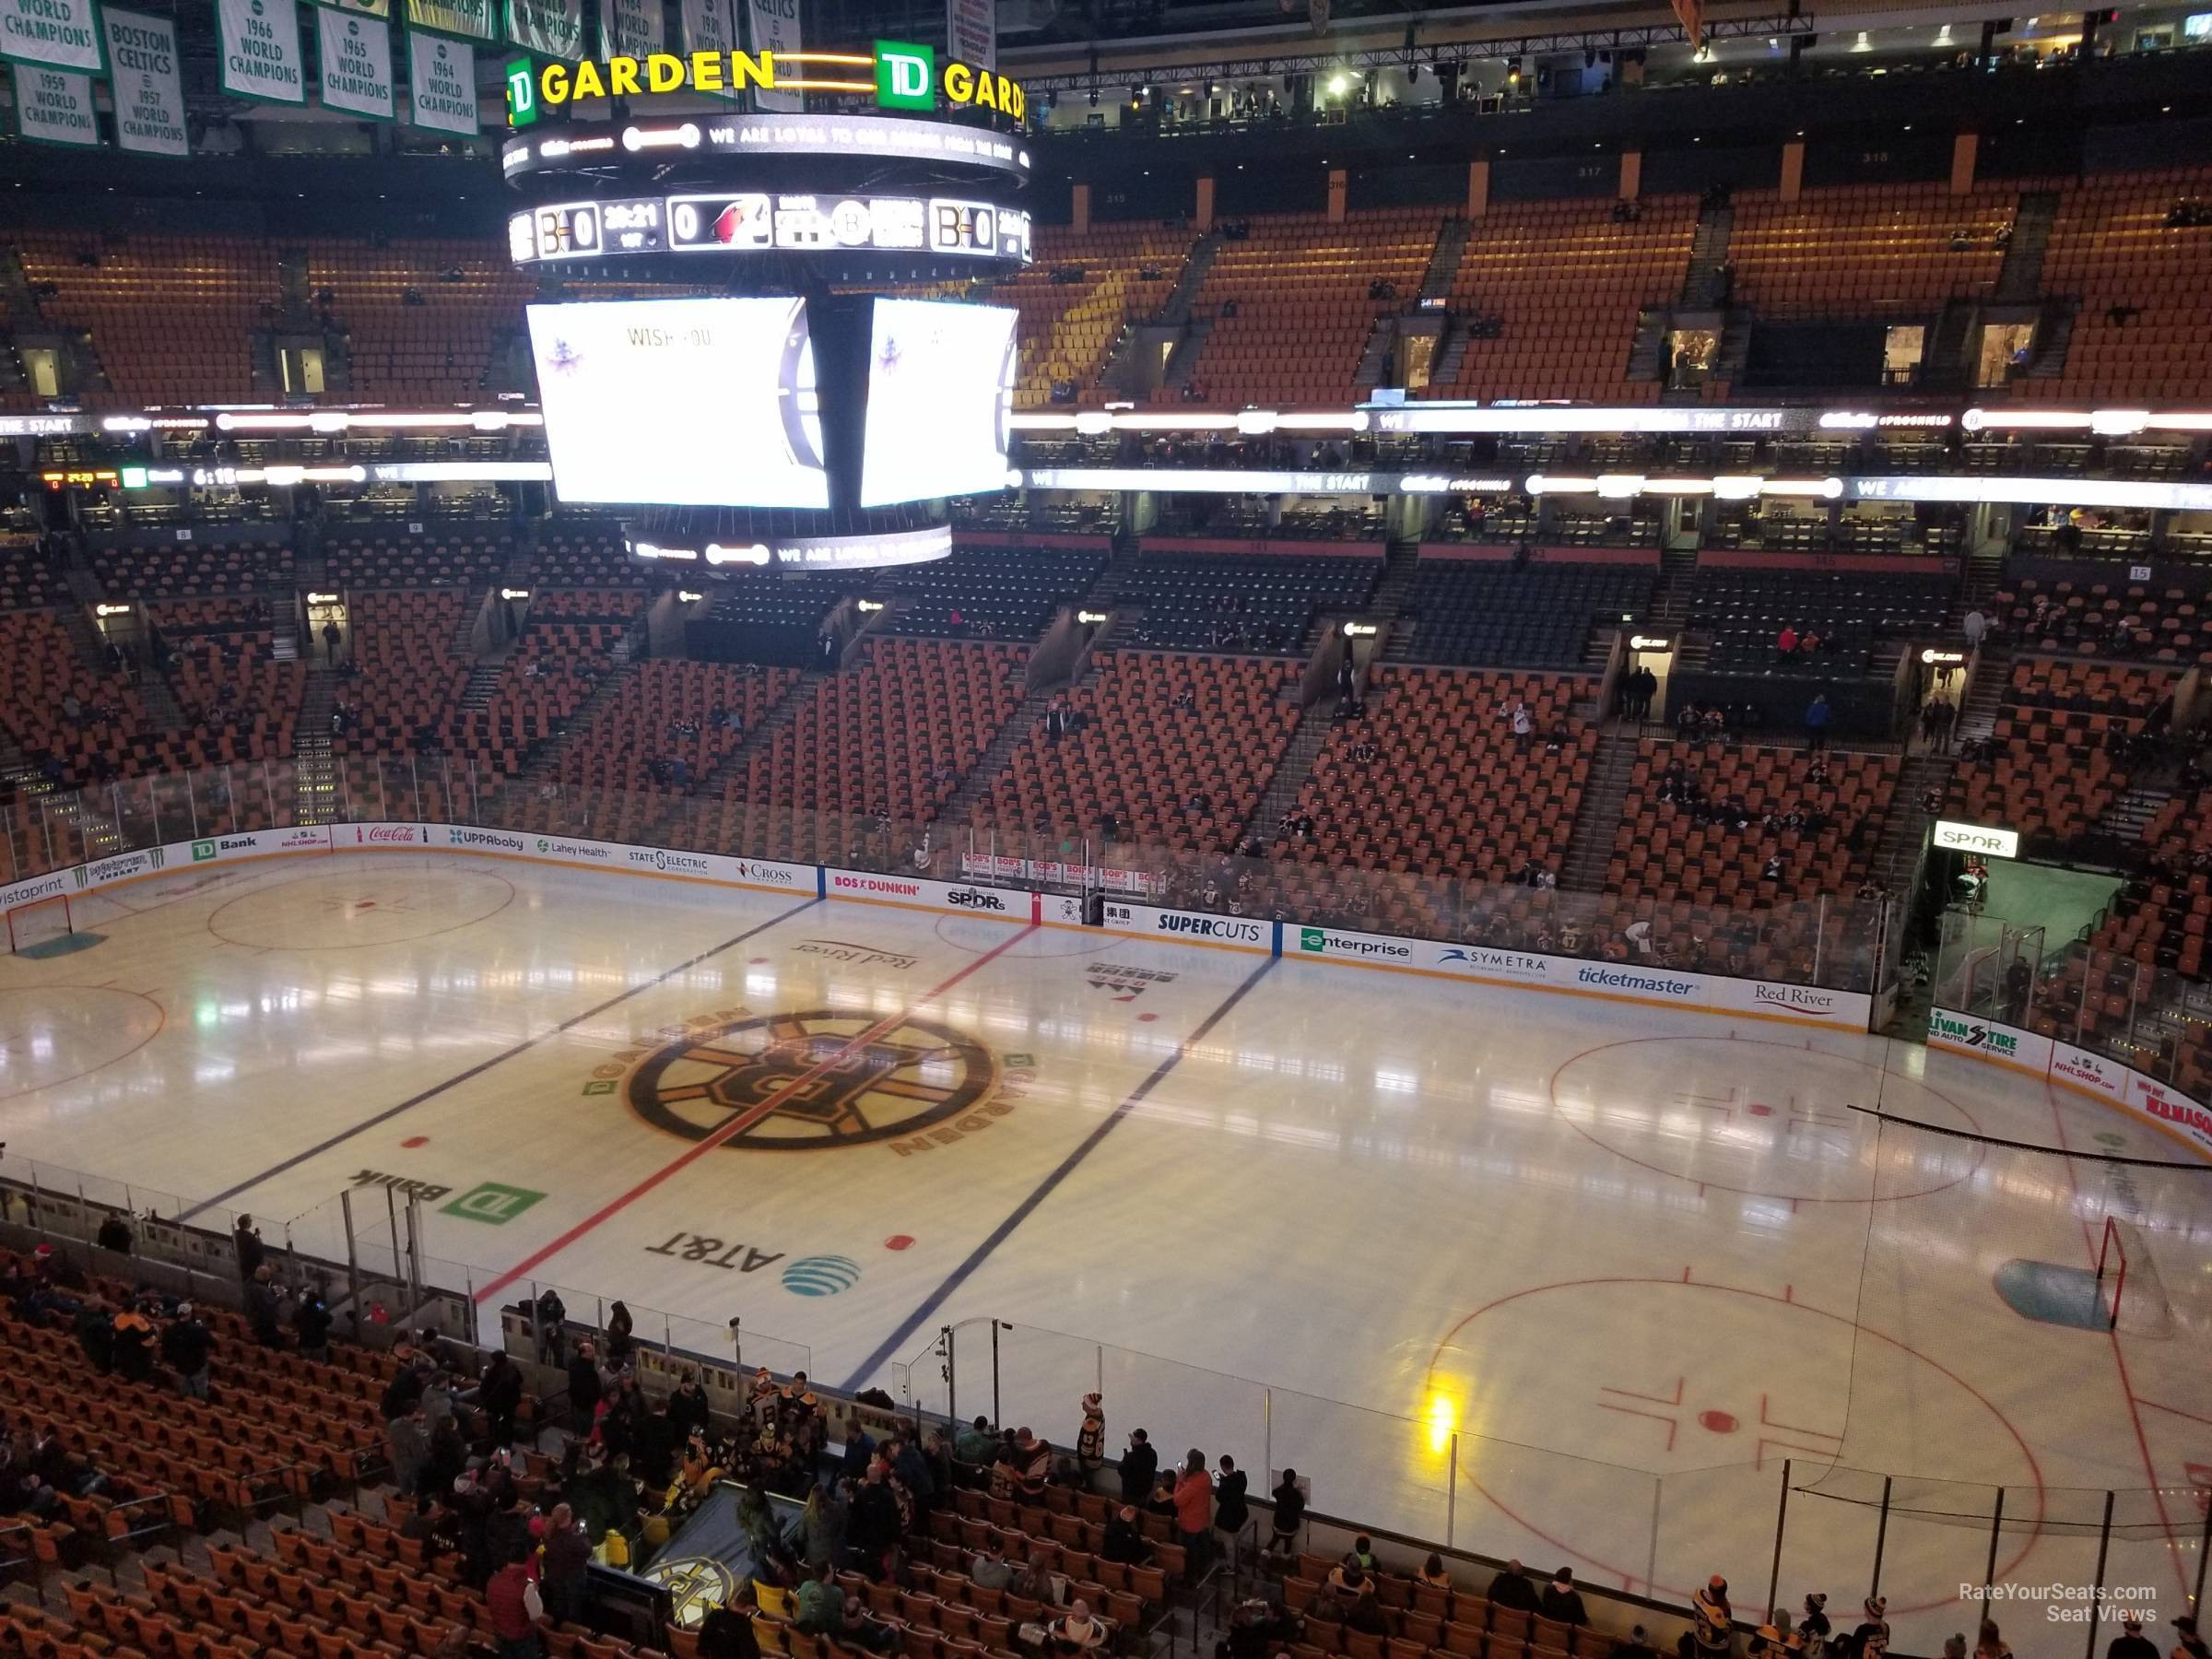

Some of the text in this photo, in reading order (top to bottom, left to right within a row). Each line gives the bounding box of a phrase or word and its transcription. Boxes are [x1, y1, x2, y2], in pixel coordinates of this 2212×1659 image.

[18, 0, 71, 21] WORLD
[6, 15, 91, 48] CHAMPIONS
[111, 23, 171, 53] BOSTON
[245, 18, 272, 39] 1966
[241, 38, 283, 61] WORLD
[343, 39, 366, 57] 1965
[117, 48, 171, 75] CELTICS
[229, 55, 298, 85] CHAMPIONS
[337, 57, 374, 78] WORLD
[433, 61, 454, 77] 1964
[41, 74, 65, 89] 1959
[541, 50, 774, 105] GARDEN
[881, 53, 929, 97] TD
[140, 89, 160, 105] 1957
[327, 73, 388, 100] CHAMPIONS
[429, 77, 462, 98] WORLD
[36, 90, 76, 111] WORLD
[418, 94, 474, 118] CHAMPIONS
[25, 107, 91, 129] CHAMPIONS
[133, 106, 170, 124] WORLD
[124, 121, 183, 141] CHAMPIONS
[709, 128, 735, 145] WE
[740, 127, 770, 144] ARE
[1578, 167, 1601, 177] 317
[574, 211, 594, 246] 0
[674, 203, 698, 240] 0
[975, 210, 992, 246] 0
[29, 419, 73, 432] START
[1695, 414, 1724, 428] THE
[1732, 413, 1783, 428] START
[1327, 476, 1370, 490] START
[1857, 480, 1886, 496] WE
[778, 548, 801, 562] WE
[2132, 567, 2149, 579] 15
[194, 836, 256, 857] TD Bank
[464, 831, 524, 852] UPPAbaby
[552, 842, 608, 859] Lahey Health
[629, 851, 654, 863] STATE
[997, 857, 1021, 866] BOB'S
[1032, 861, 1057, 871] BOB'S
[1102, 869, 1127, 878] BOB'S
[834, 876, 920, 897] BOS DUNKIN'
[1158, 913, 1261, 942] SUPERCUTS
[1301, 932, 1410, 958] enterprise
[791, 943, 917, 971] Red River
[1470, 950, 1547, 971] SYMETRA
[1577, 966, 1694, 995] ticketmaster
[1755, 983, 1833, 1007] Red River
[1941, 1032, 1963, 1042] AUTO
[1981, 1042, 2016, 1057] SERVICE
[1987, 1030, 2018, 1050] TIRE
[347, 1169, 453, 1202] Bank
[645, 1231, 786, 1274] AT&T
